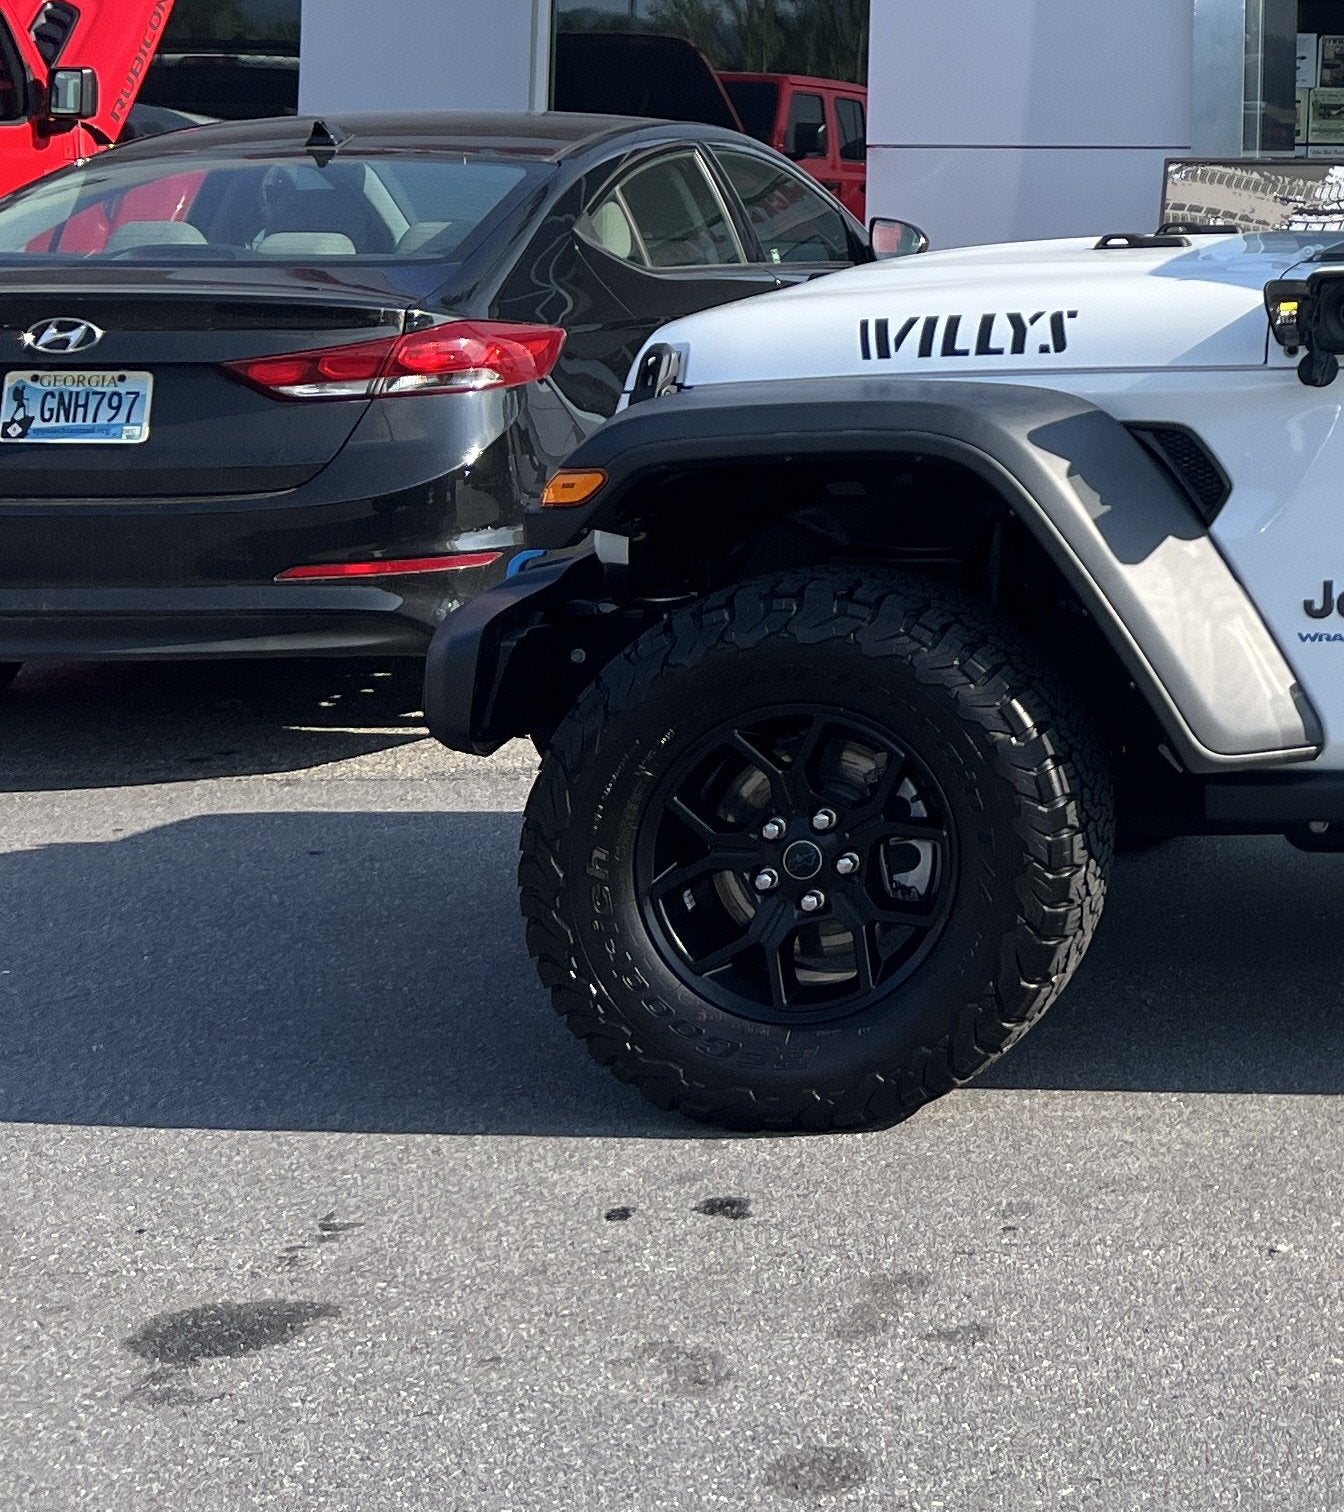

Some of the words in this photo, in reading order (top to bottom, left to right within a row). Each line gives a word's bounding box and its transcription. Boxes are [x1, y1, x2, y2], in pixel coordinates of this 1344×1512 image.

[859, 309, 1079, 360] WILLYS
[40, 374, 118, 388] GEORGIA
[40, 391, 140, 423] GNH797
